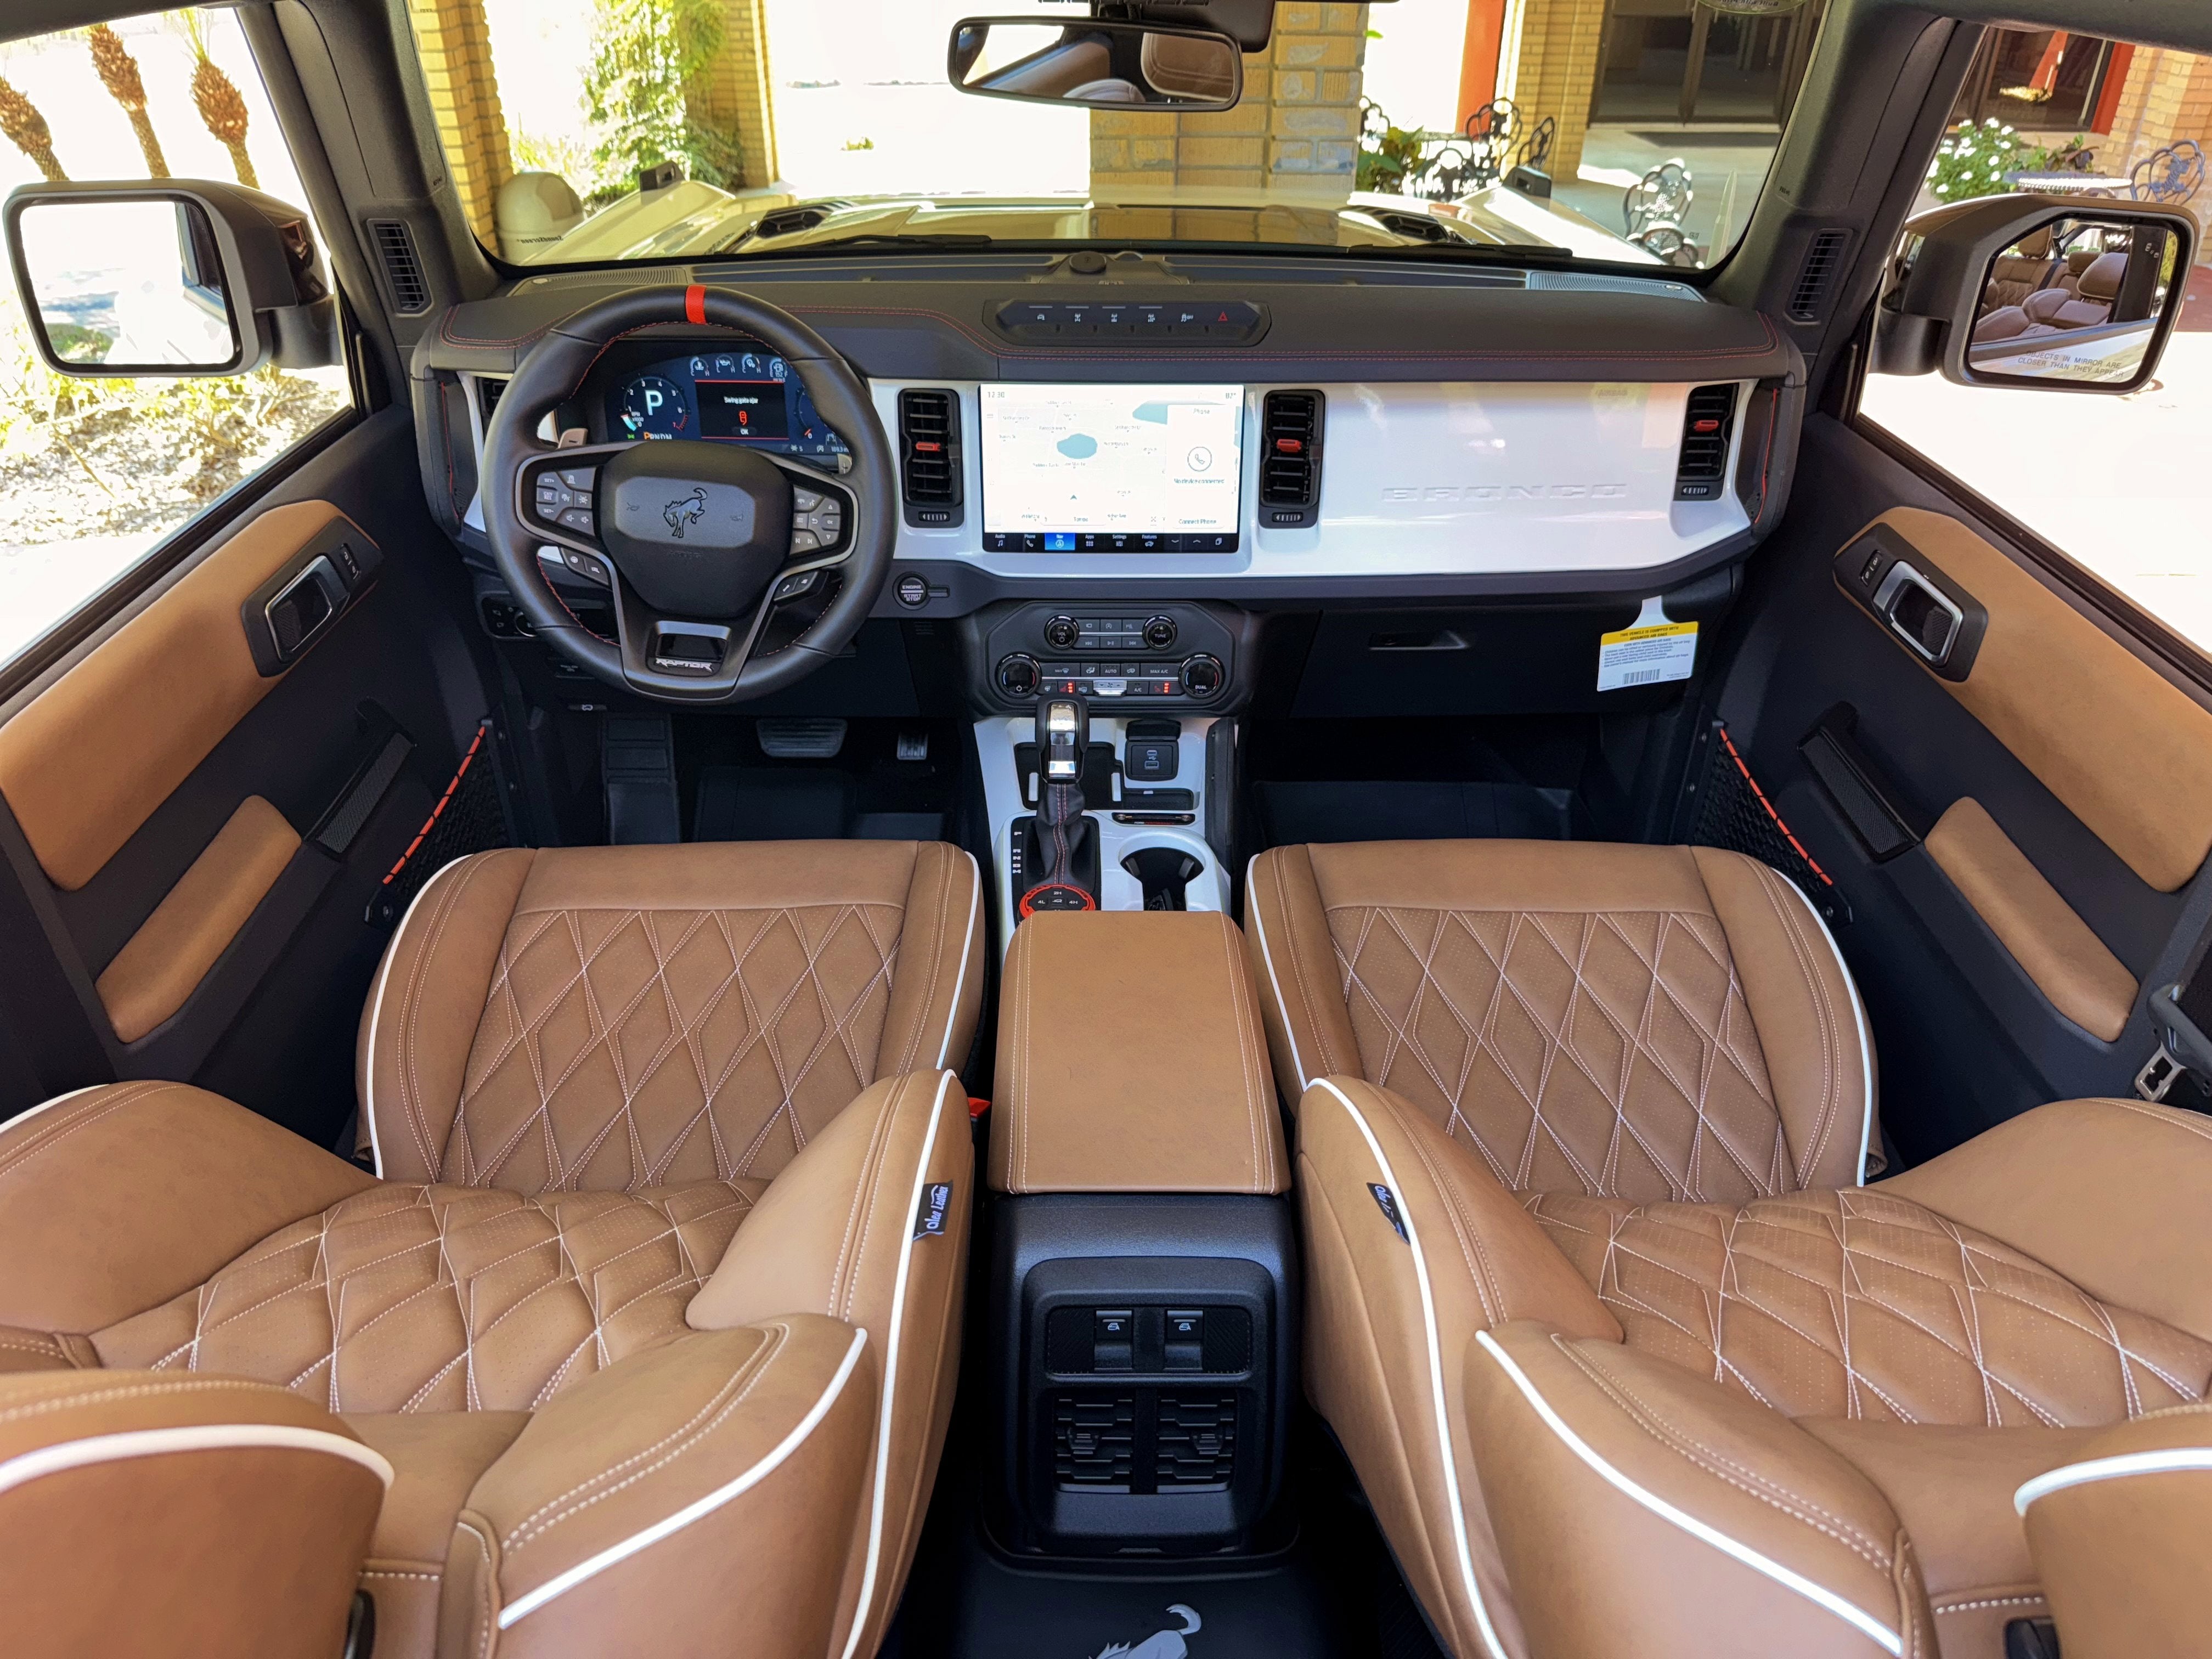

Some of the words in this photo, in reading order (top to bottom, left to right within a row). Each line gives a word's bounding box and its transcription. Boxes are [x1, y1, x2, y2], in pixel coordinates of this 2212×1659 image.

[2018, 357, 2046, 367] CLOSER
[2050, 362, 2070, 370] THAN
[2074, 365, 2092, 373] THEY
[2095, 368, 2124, 377] APPEAR
[2027, 351, 2058, 361] OBJECTS
[2074, 357, 2103, 367] MIRROR
[2106, 361, 2122, 369] ARE
[645, 390, 663, 416] P
[1383, 484, 1627, 502] BRONCO
[656, 658, 713, 673] RAPTOR
